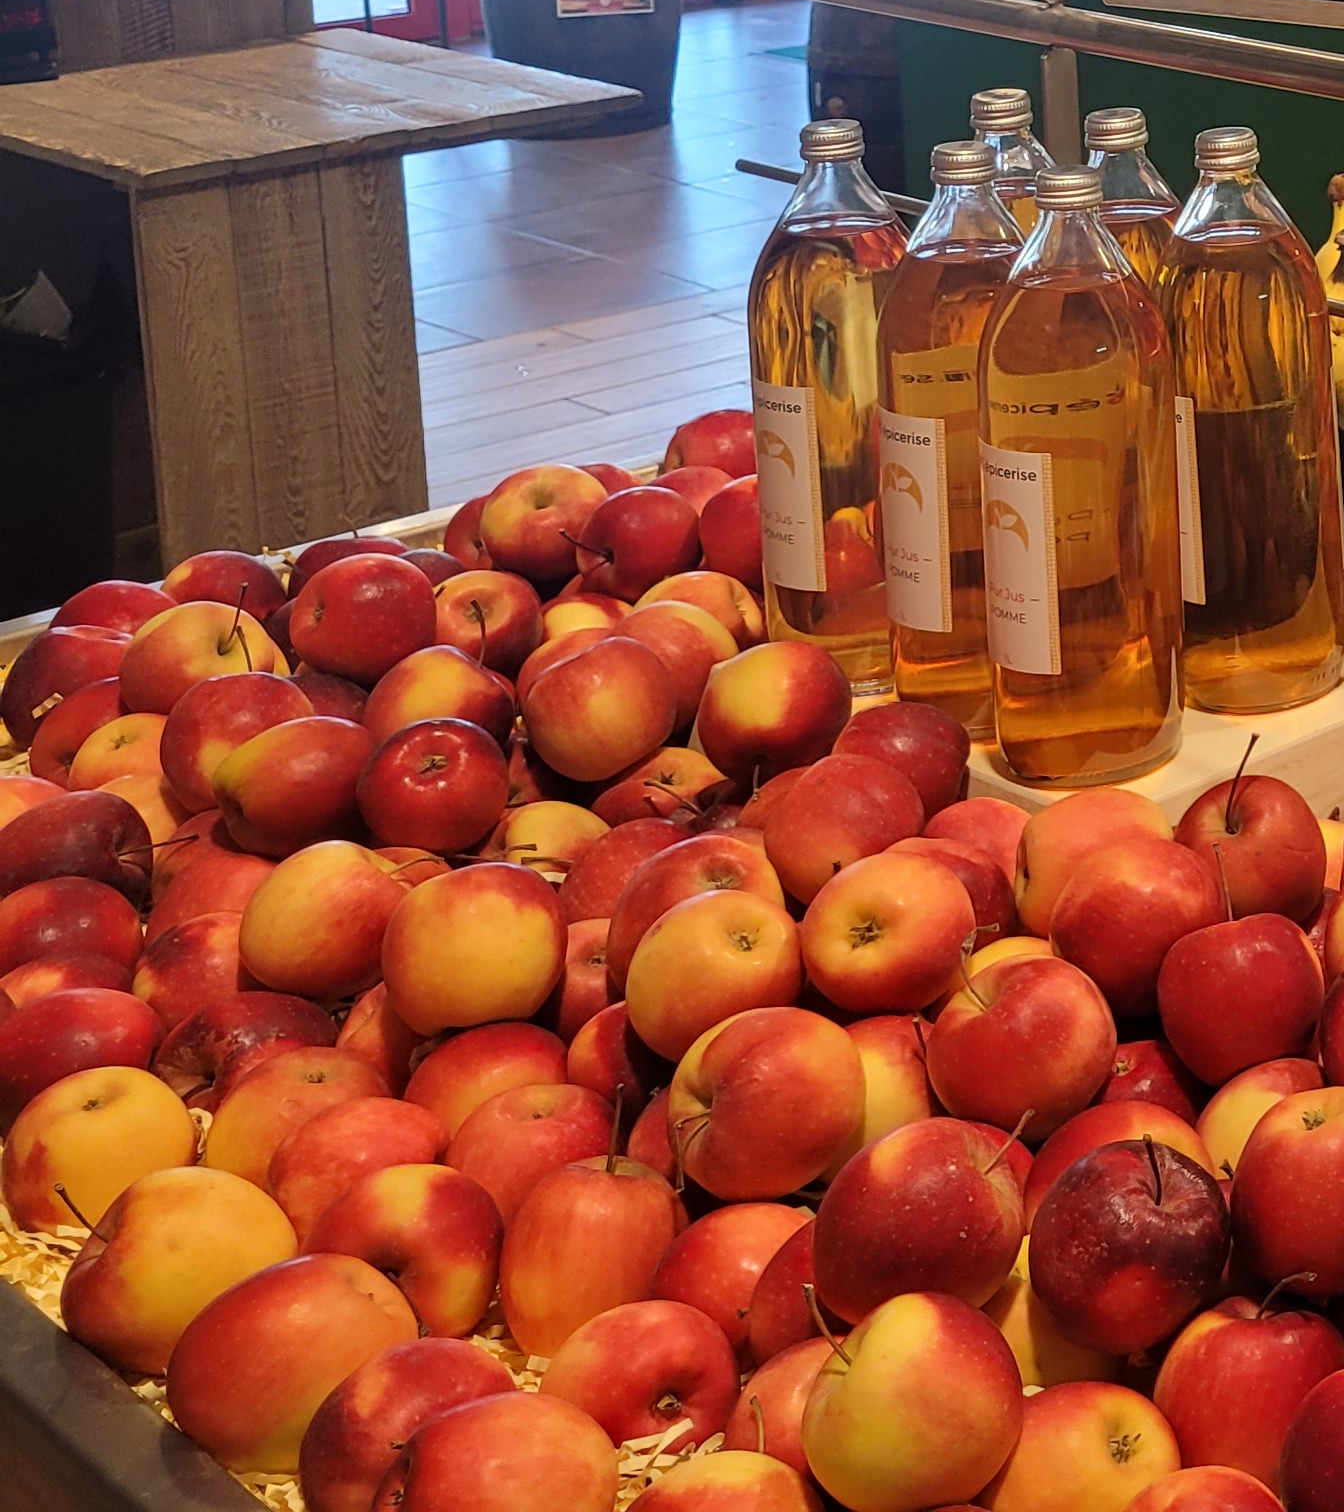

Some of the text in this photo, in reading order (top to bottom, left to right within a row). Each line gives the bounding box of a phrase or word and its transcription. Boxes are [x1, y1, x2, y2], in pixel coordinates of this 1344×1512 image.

[899, 549, 919, 563] Jus
[1003, 586, 1025, 603] Jus
[990, 600, 1028, 625] POMME
